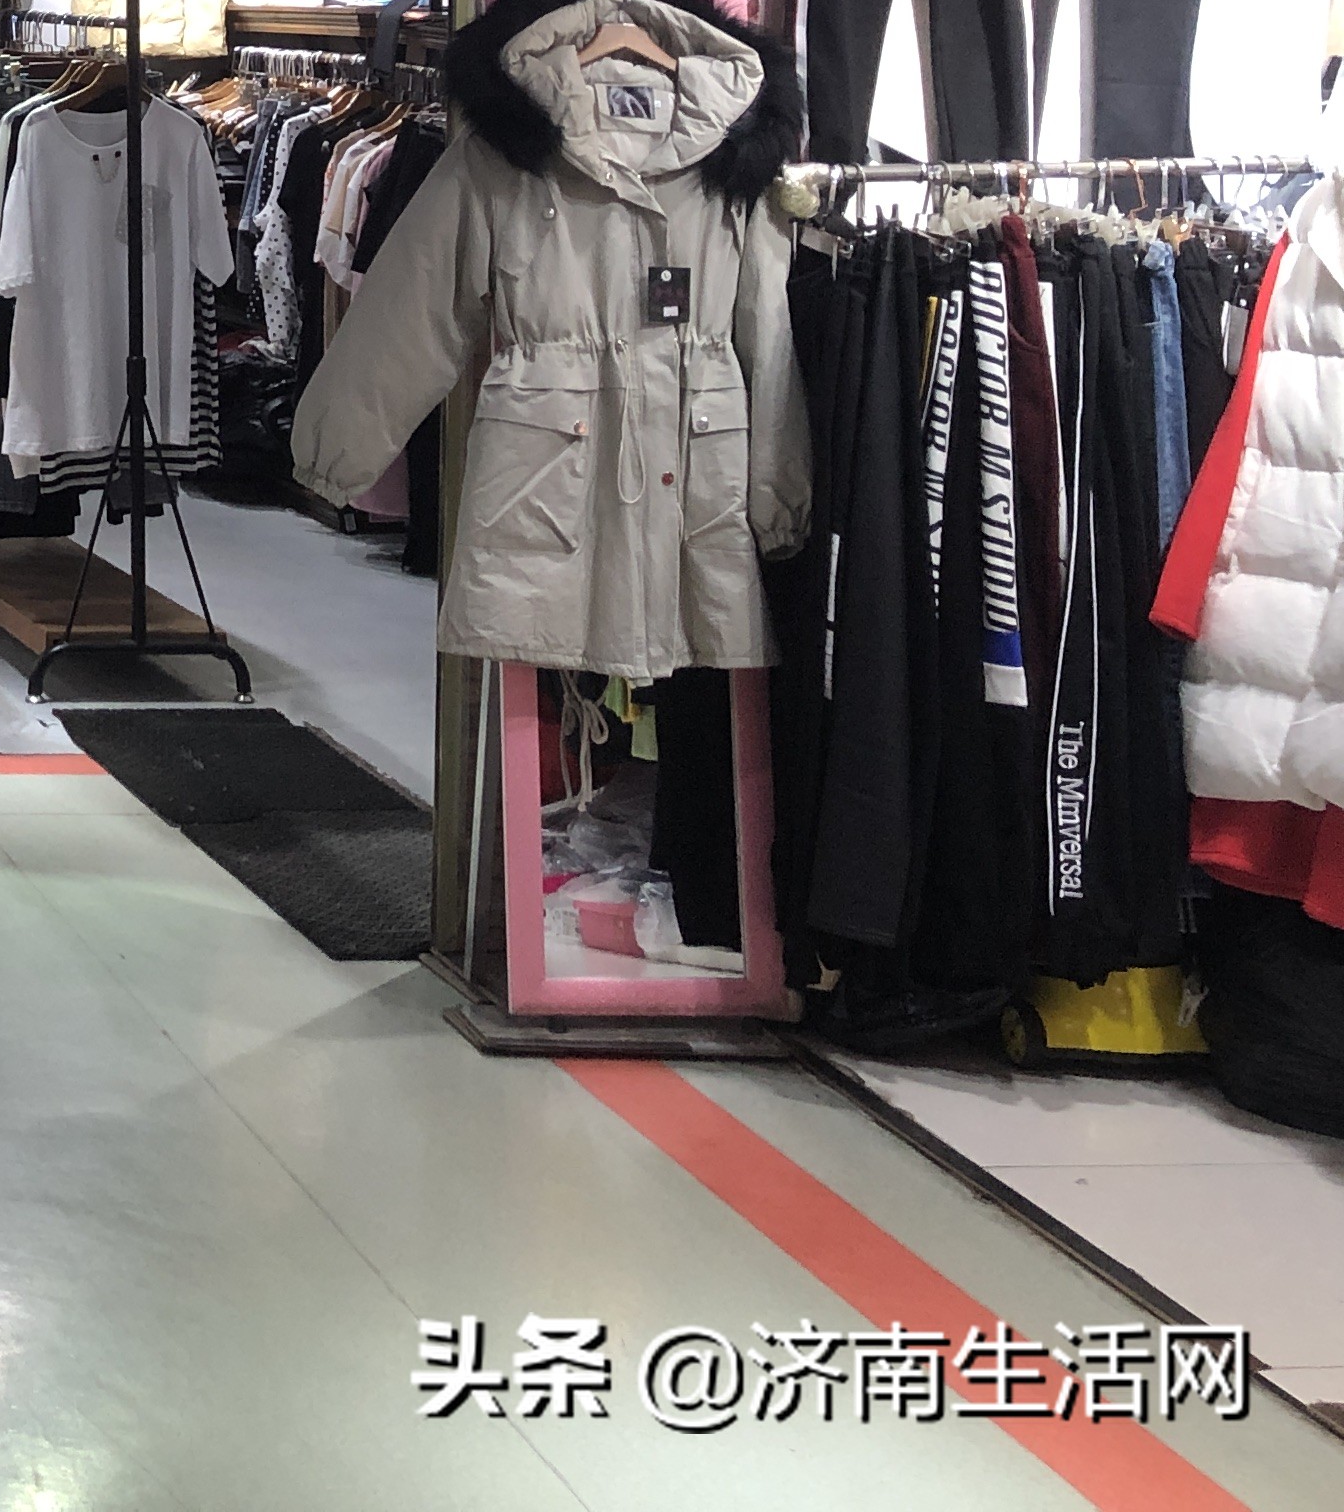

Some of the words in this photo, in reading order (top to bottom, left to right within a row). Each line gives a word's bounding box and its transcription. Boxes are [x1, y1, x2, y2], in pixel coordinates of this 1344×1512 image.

[969, 263, 1009, 427] DOCTOR
[980, 438, 1011, 480] M
[1057, 720, 1085, 770] The
